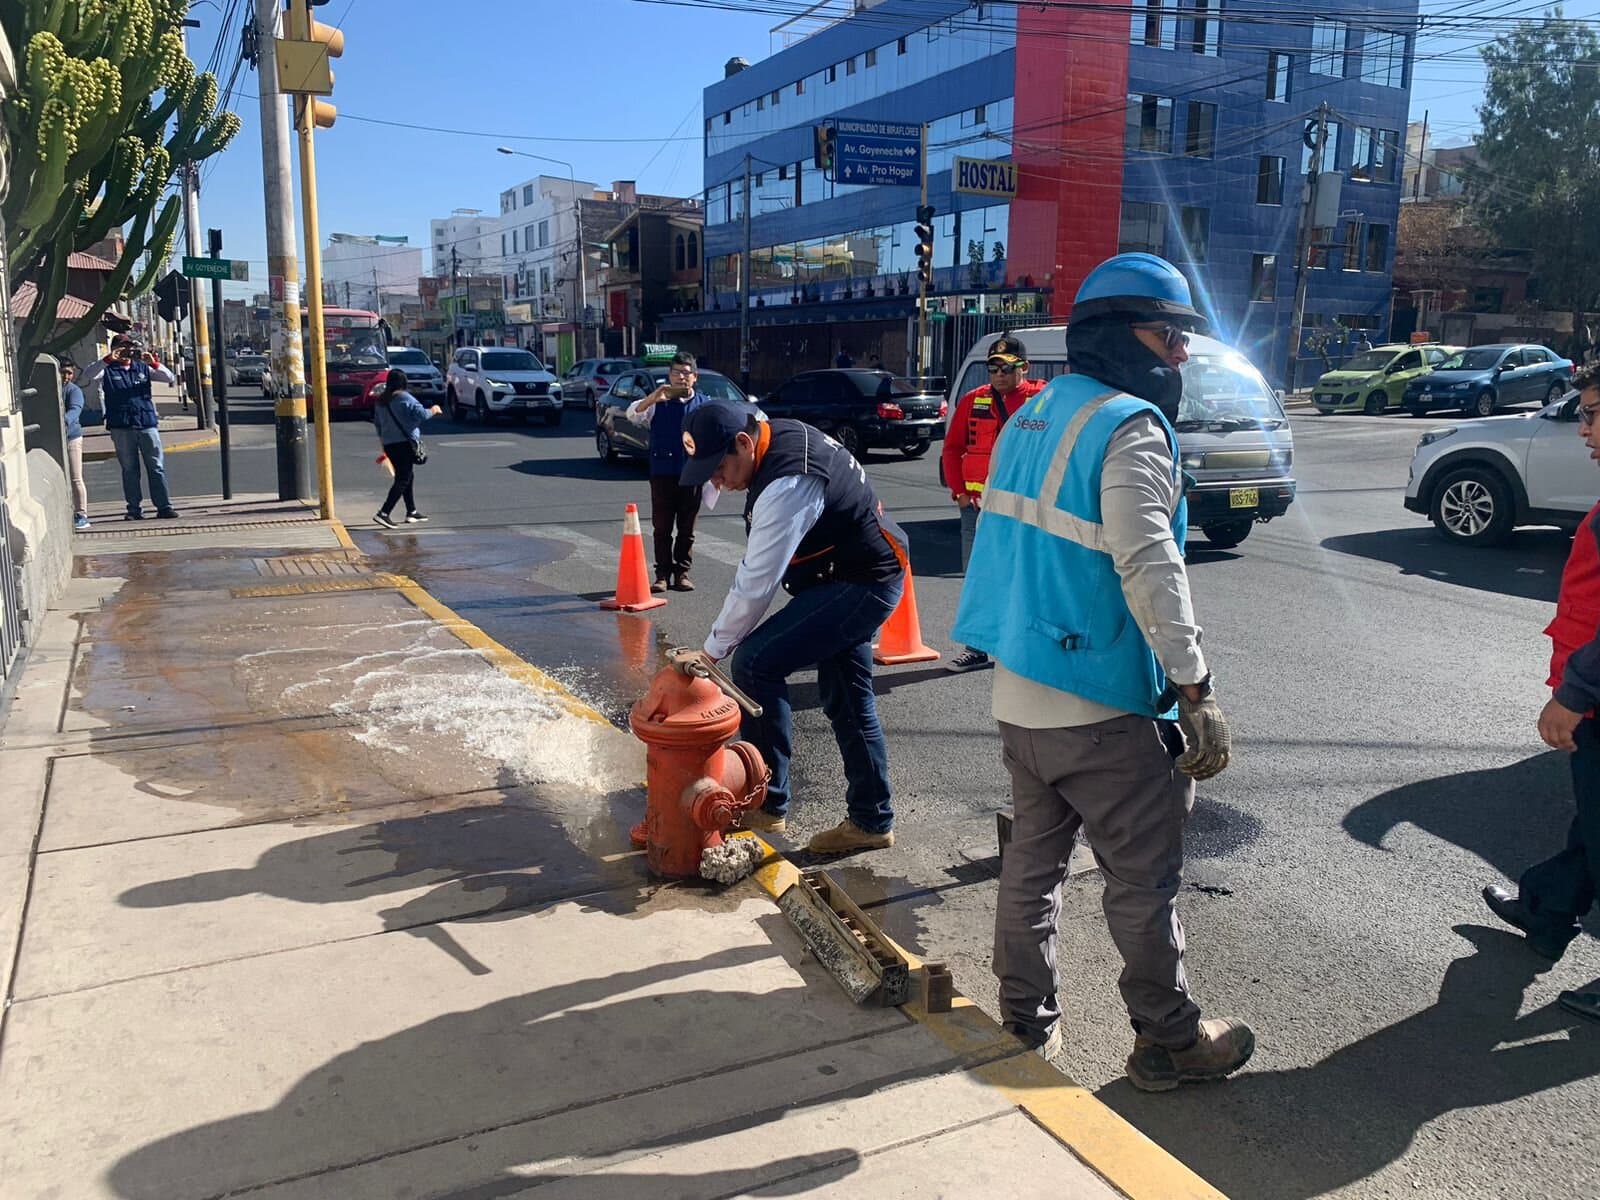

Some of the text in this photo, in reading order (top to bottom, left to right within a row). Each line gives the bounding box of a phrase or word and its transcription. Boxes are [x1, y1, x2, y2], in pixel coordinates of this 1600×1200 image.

[886, 125, 919, 136] MIRAFLORES
[844, 143, 904, 157] Av. Goyeneche
[856, 164, 914, 178] Av. Pro Hogar
[958, 160, 1016, 193] HOSTAL
